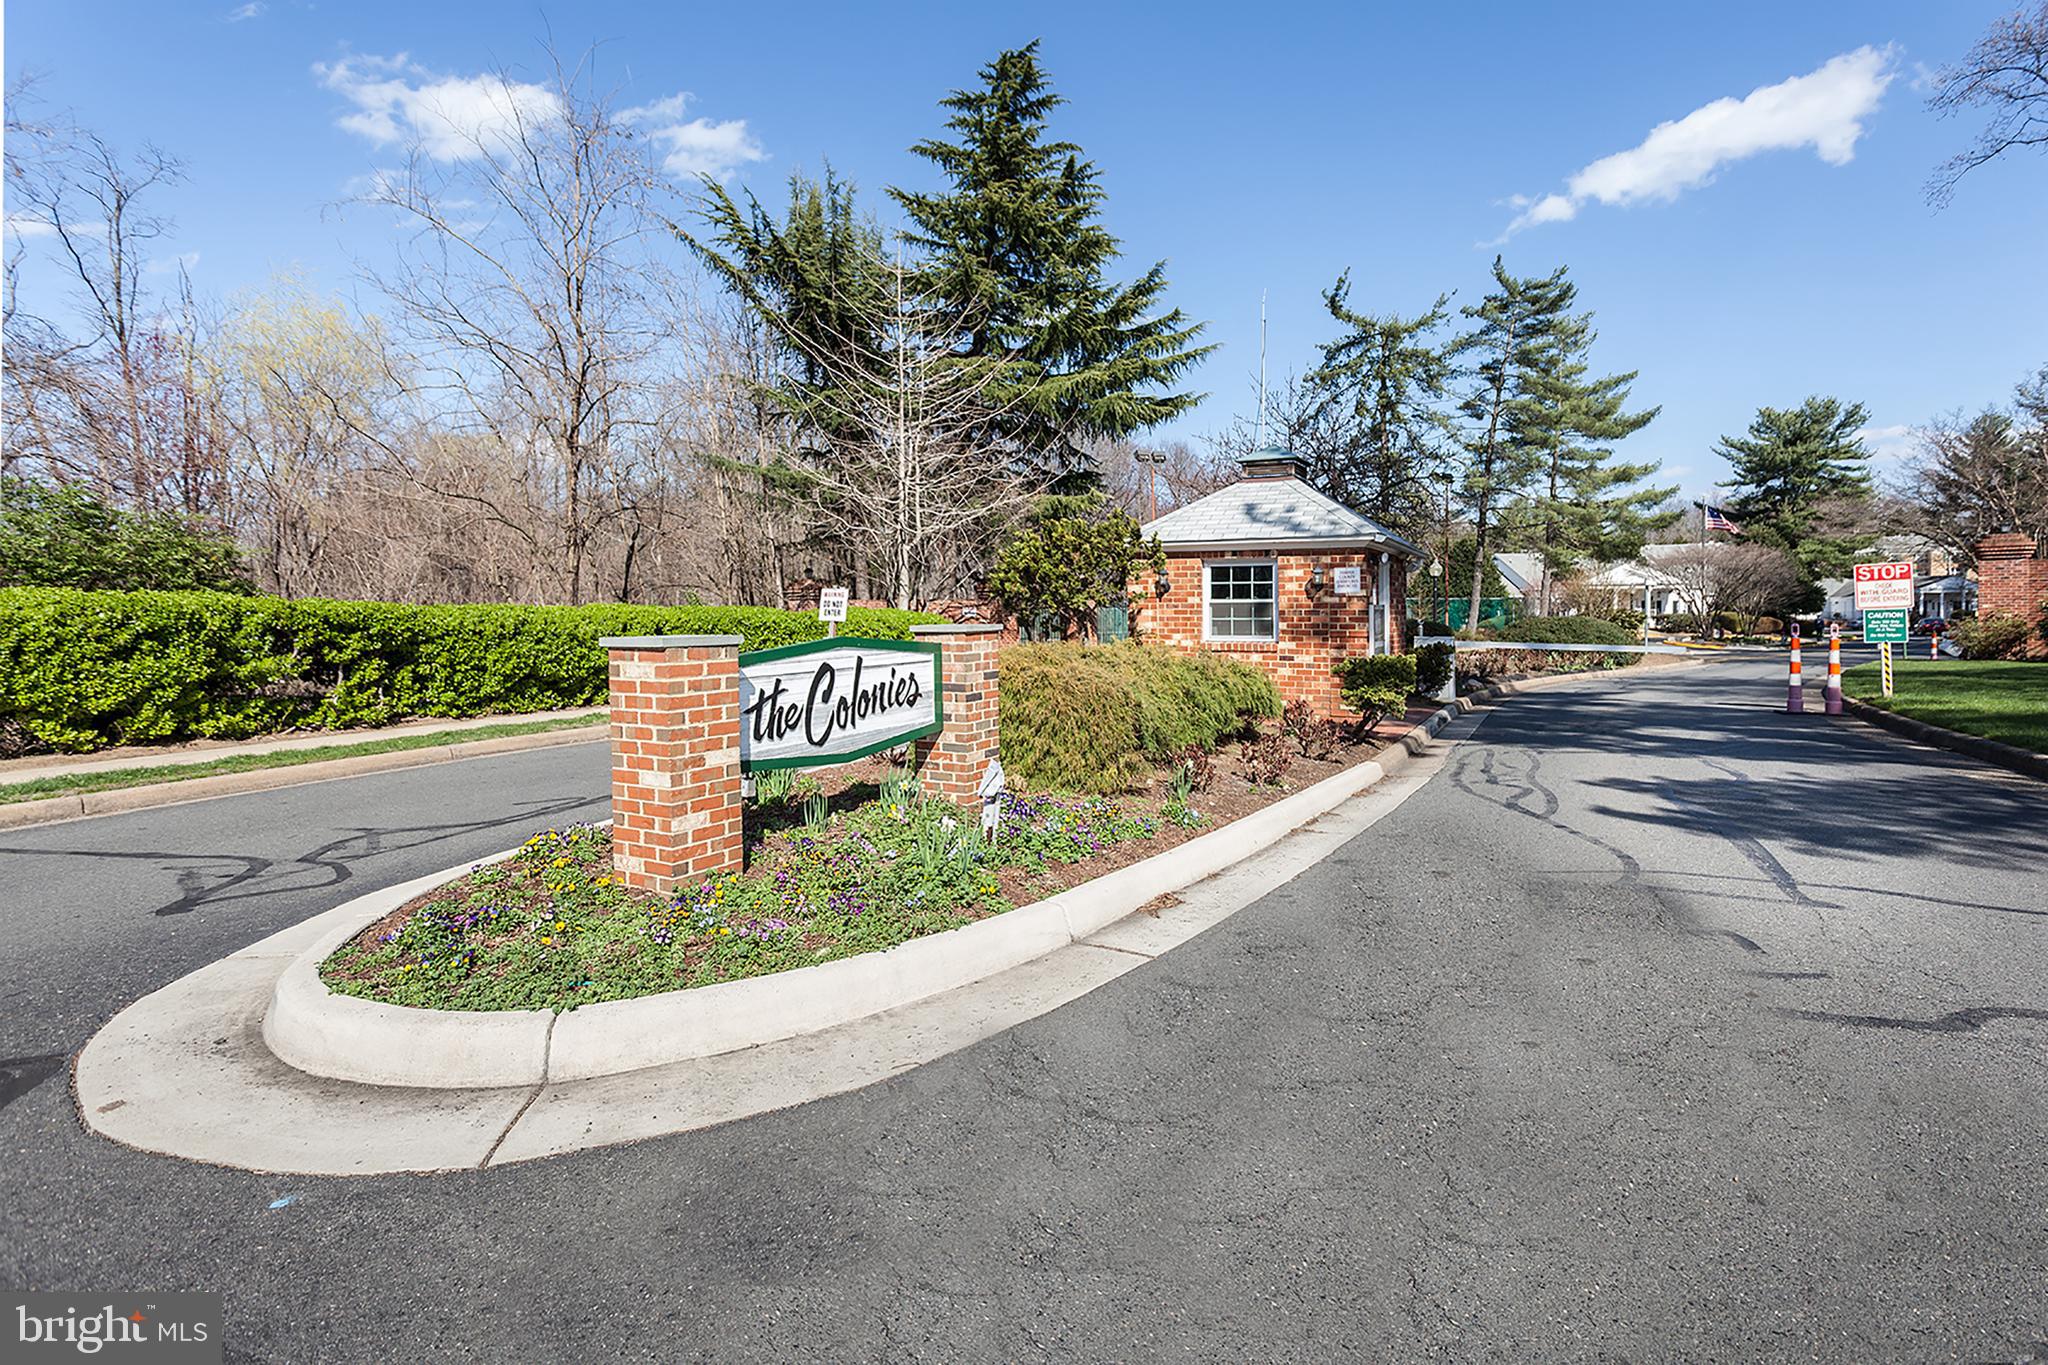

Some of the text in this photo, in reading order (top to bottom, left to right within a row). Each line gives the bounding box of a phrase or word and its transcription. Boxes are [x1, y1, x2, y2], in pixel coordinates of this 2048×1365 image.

[1858, 565, 1909, 580] STOP
[823, 600, 843, 608] DO NOT
[743, 655, 923, 747] the Colonies
